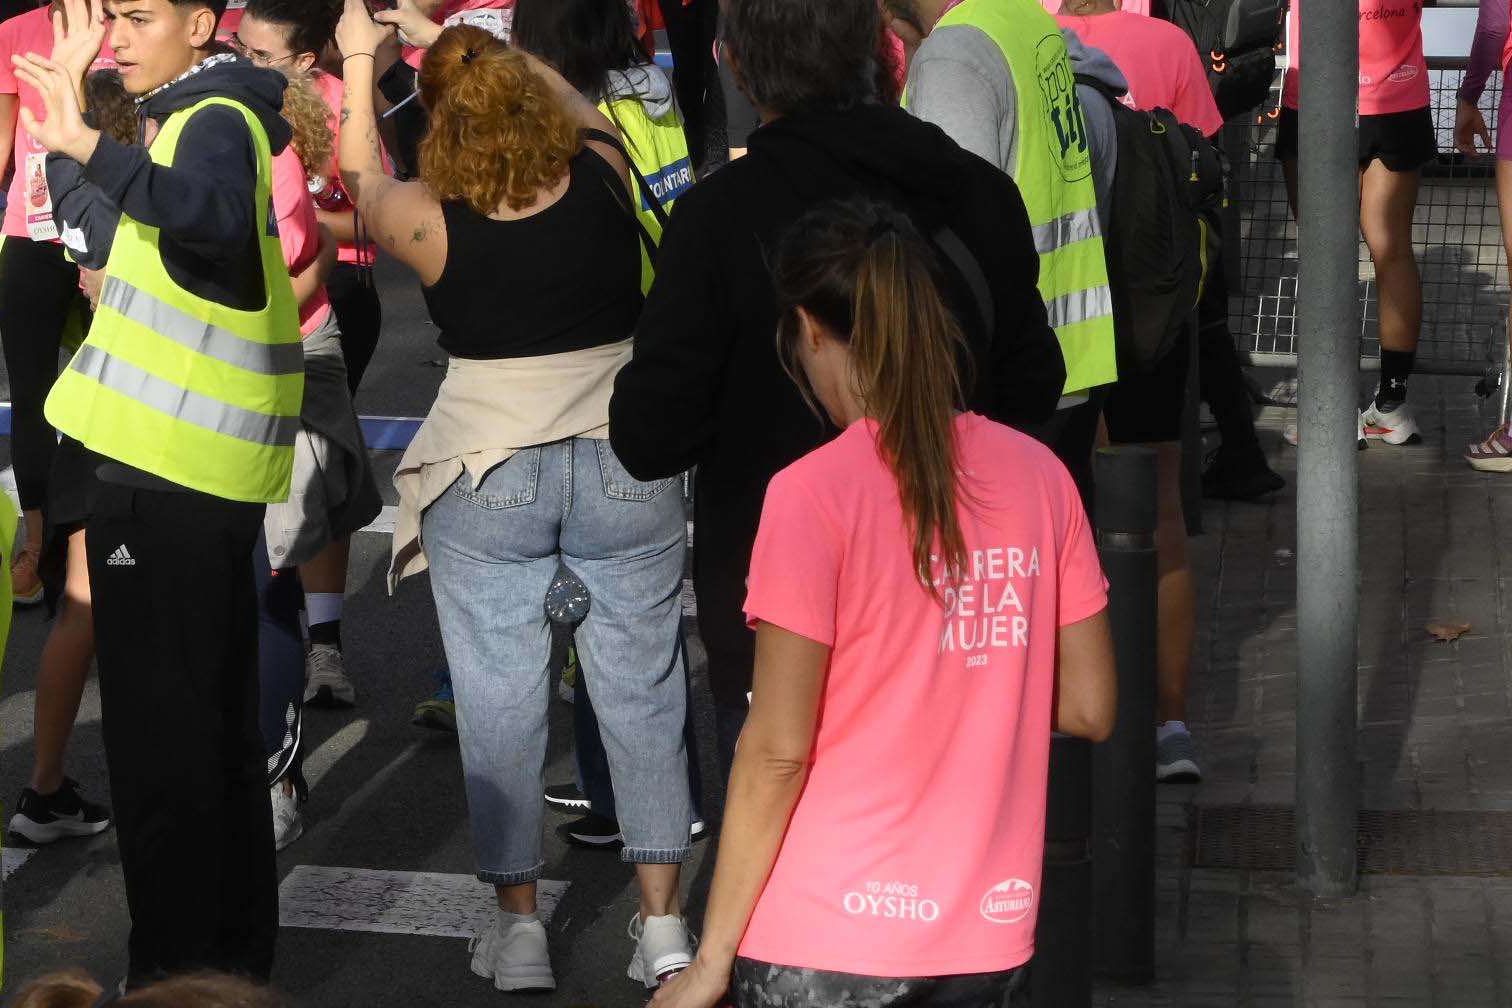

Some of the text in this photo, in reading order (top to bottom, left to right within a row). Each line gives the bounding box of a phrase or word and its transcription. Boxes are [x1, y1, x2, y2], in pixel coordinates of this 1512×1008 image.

[106, 556, 136, 566] adidas
[944, 580, 1024, 618] DE LA
[937, 615, 1028, 655] MUJER
[965, 654, 988, 669] 2023
[884, 879, 919, 898] AÑOS
[843, 891, 940, 922] OYSHO
[984, 895, 1031, 914] ASTURIANA
